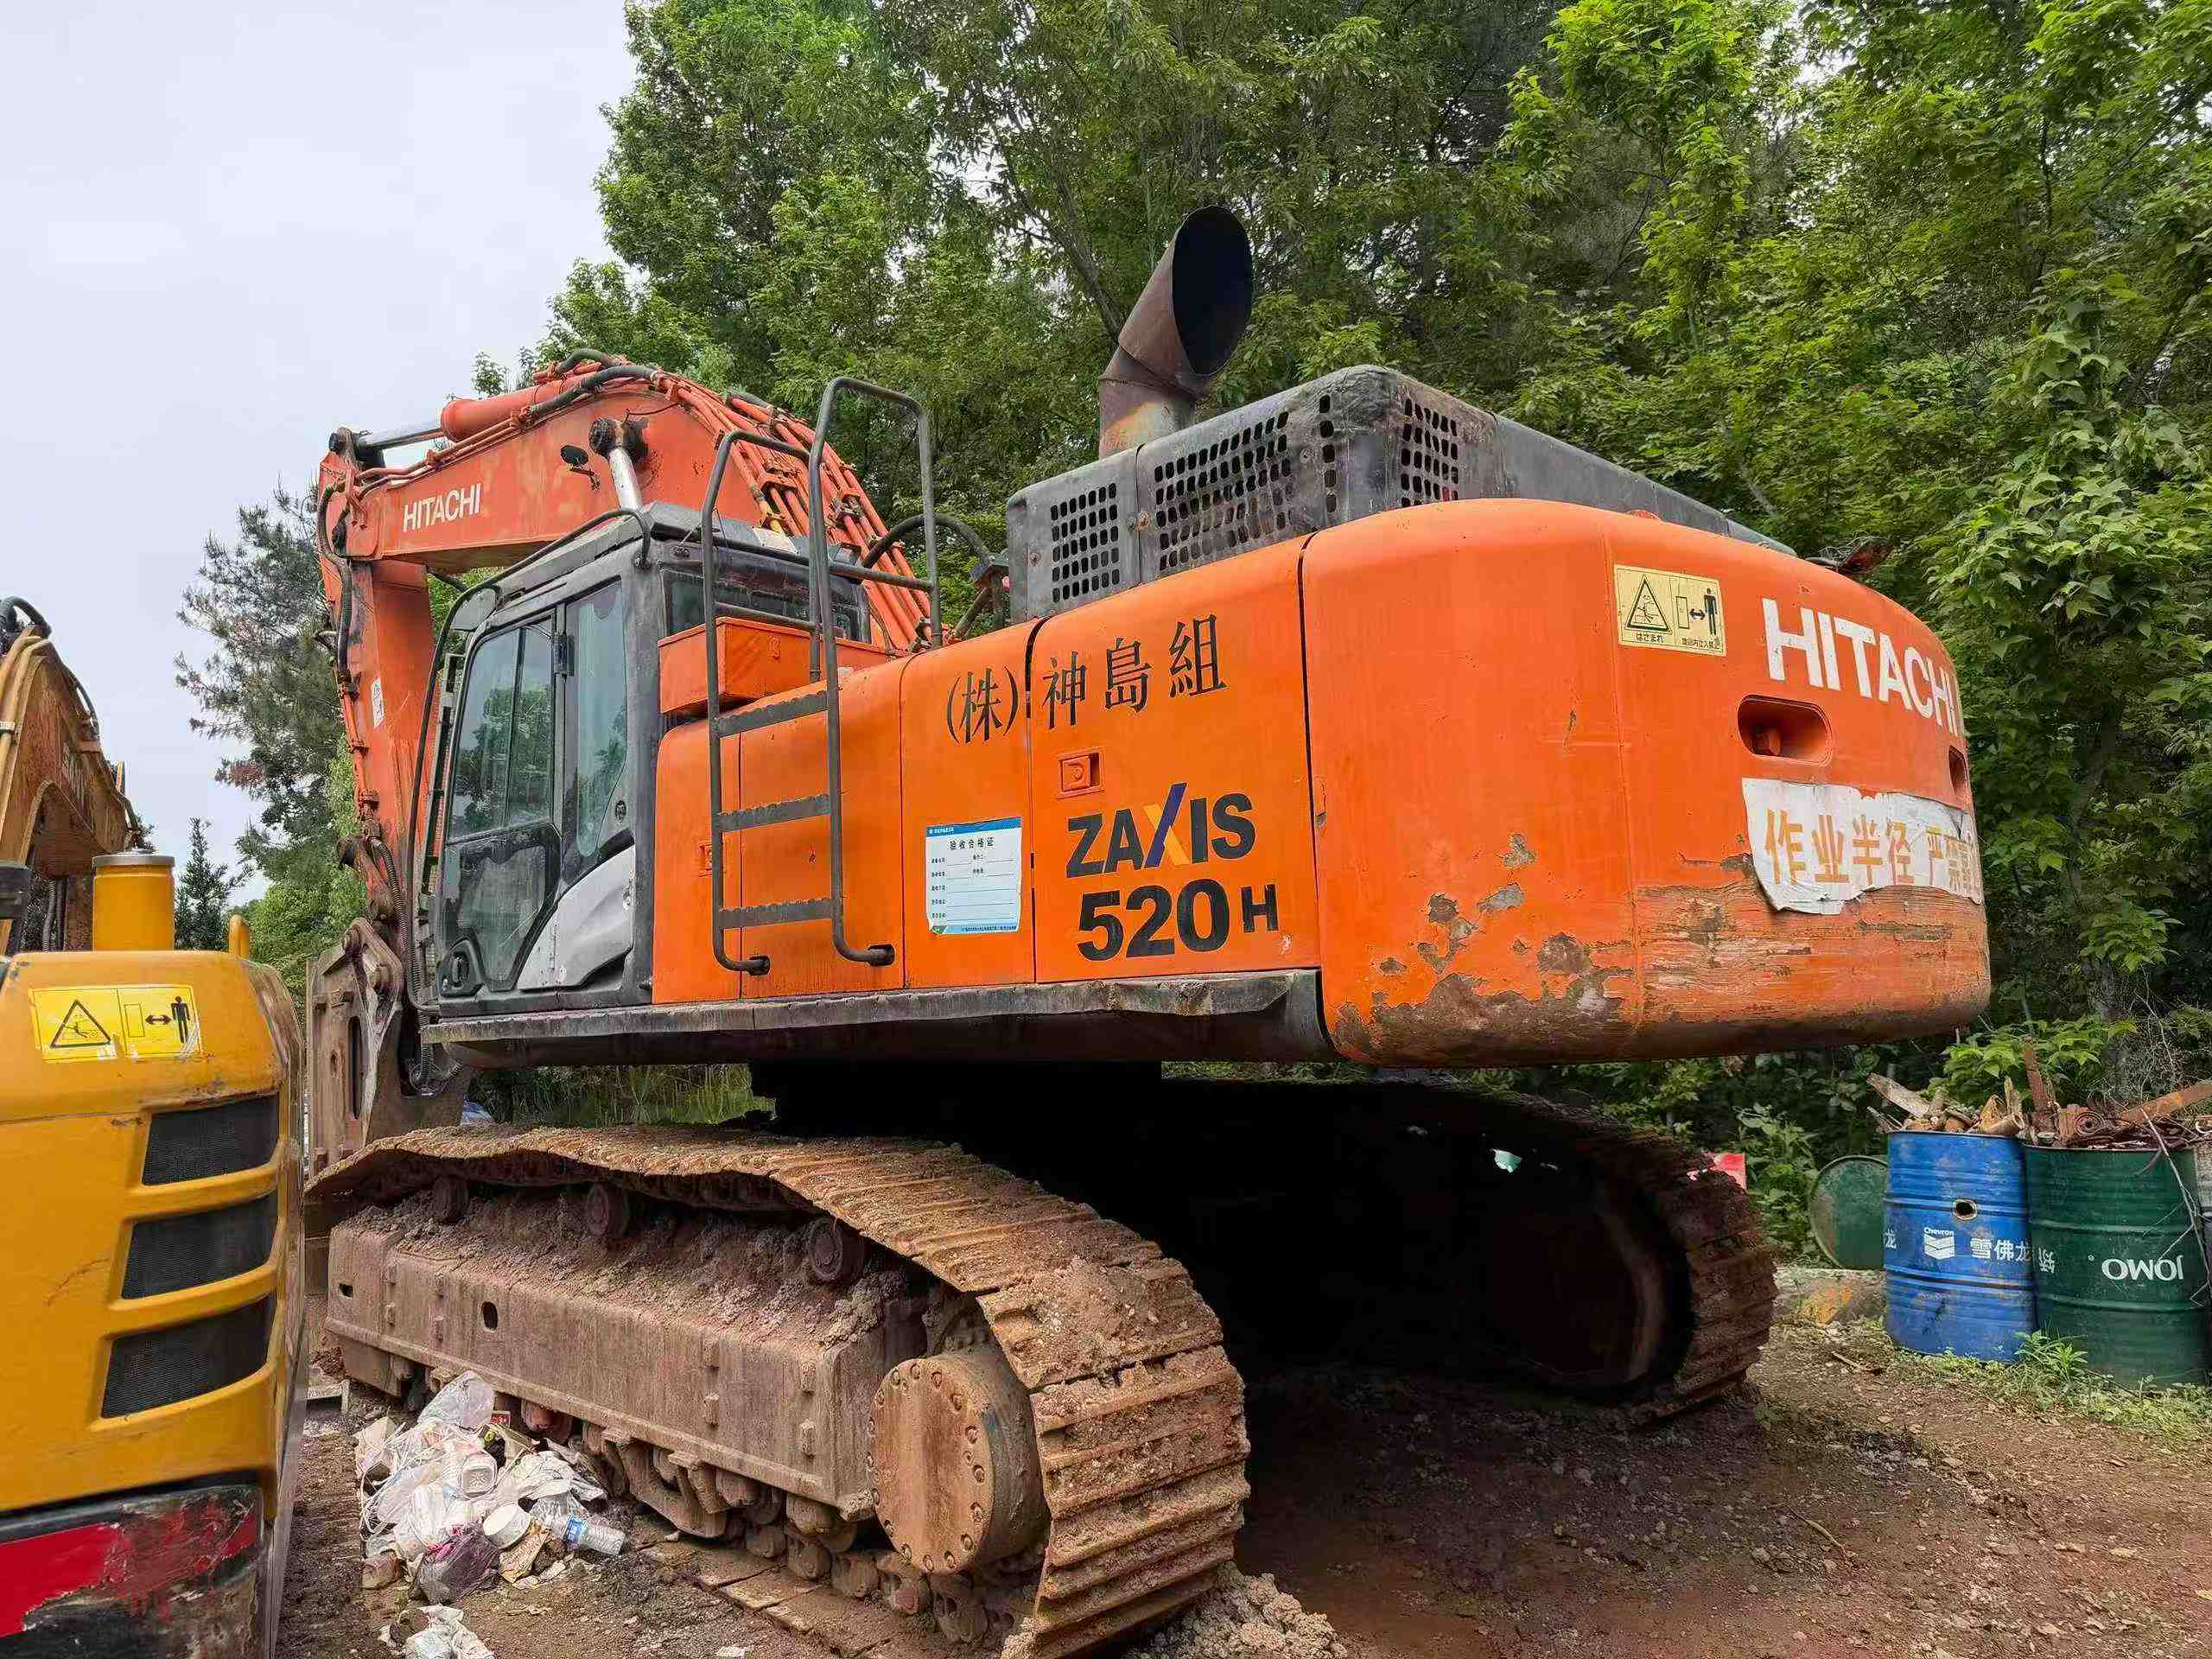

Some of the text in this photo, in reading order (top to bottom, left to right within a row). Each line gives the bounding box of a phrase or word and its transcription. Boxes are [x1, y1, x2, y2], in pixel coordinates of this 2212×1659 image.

[403, 483, 481, 532] HITACHI
[1762, 598, 1958, 736] HITACHI
[1066, 782, 1255, 878] ZAXIS
[1923, 1227, 1955, 1236] Chevron
[1970, 1237, 2032, 1262] 雪佛龙
